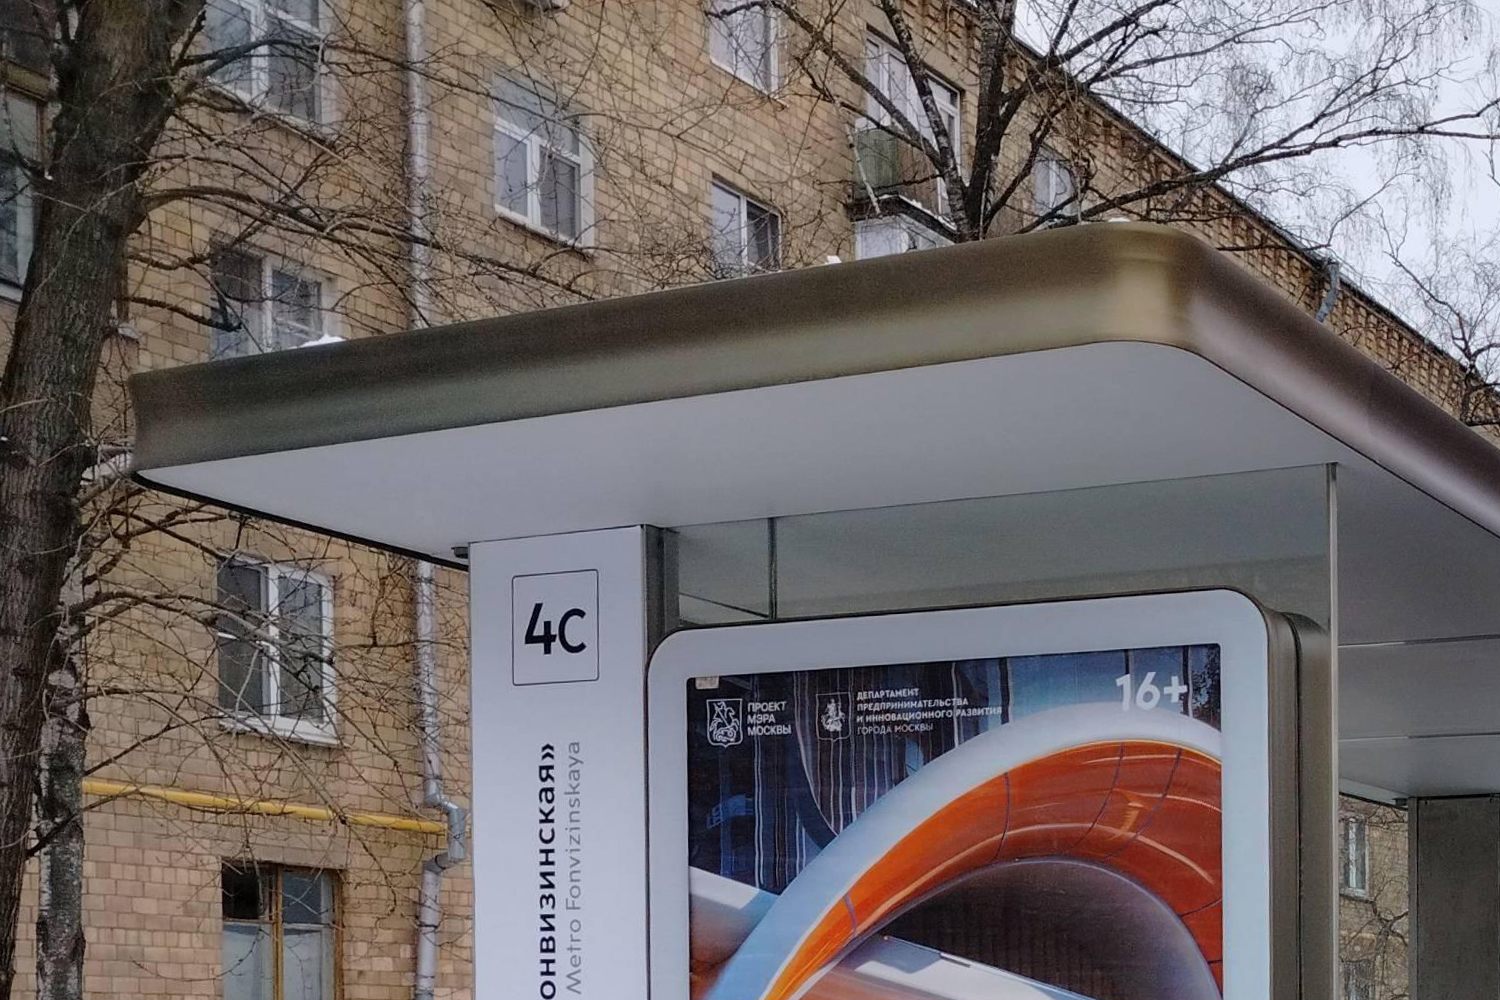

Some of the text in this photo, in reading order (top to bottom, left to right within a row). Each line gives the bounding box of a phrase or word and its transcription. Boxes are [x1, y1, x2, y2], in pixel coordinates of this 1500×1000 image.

[856, 687, 920, 701] ДЕПАРТАМЕНТ
[1115, 671, 1188, 712] 16+
[747, 700, 788, 713] ПРОЕКТ
[856, 697, 969, 712] ПРЕДПРИНИМАТЕЛЬСТВА
[747, 713, 776, 724] МЭРА
[856, 706, 1003, 723] И ИННОВАЦИОННОГО РАЗВИТИЯ
[747, 724, 792, 736] МОСКВЫ
[856, 722, 934, 735] ГОРОДА МОСКВЫ
[563, 741, 584, 995] Metro Fonvizinskaya
